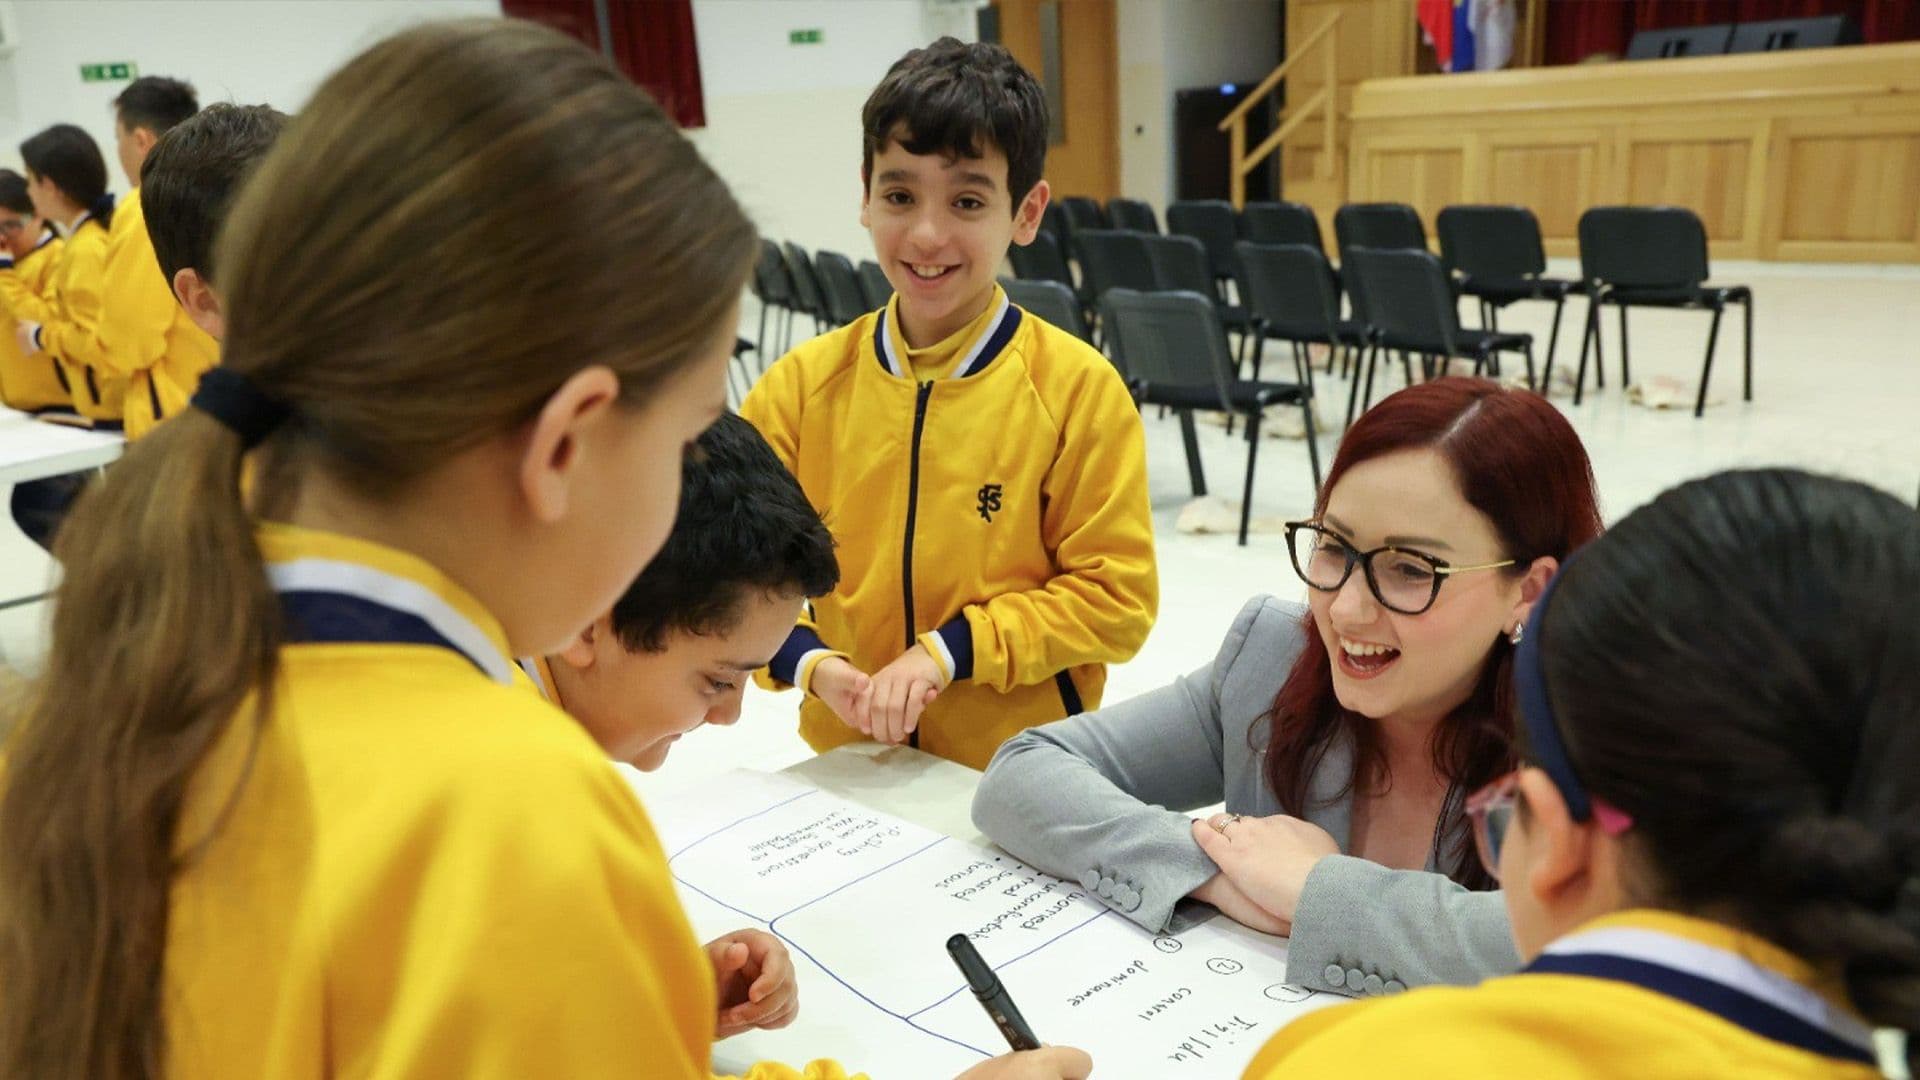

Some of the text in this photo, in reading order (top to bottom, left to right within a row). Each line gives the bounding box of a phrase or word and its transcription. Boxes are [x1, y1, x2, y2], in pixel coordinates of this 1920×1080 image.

[951, 869, 1013, 901] scared
[1019, 891, 1085, 931] worried
[1067, 959, 1149, 1007] dominance
[1137, 987, 1192, 1022] control
